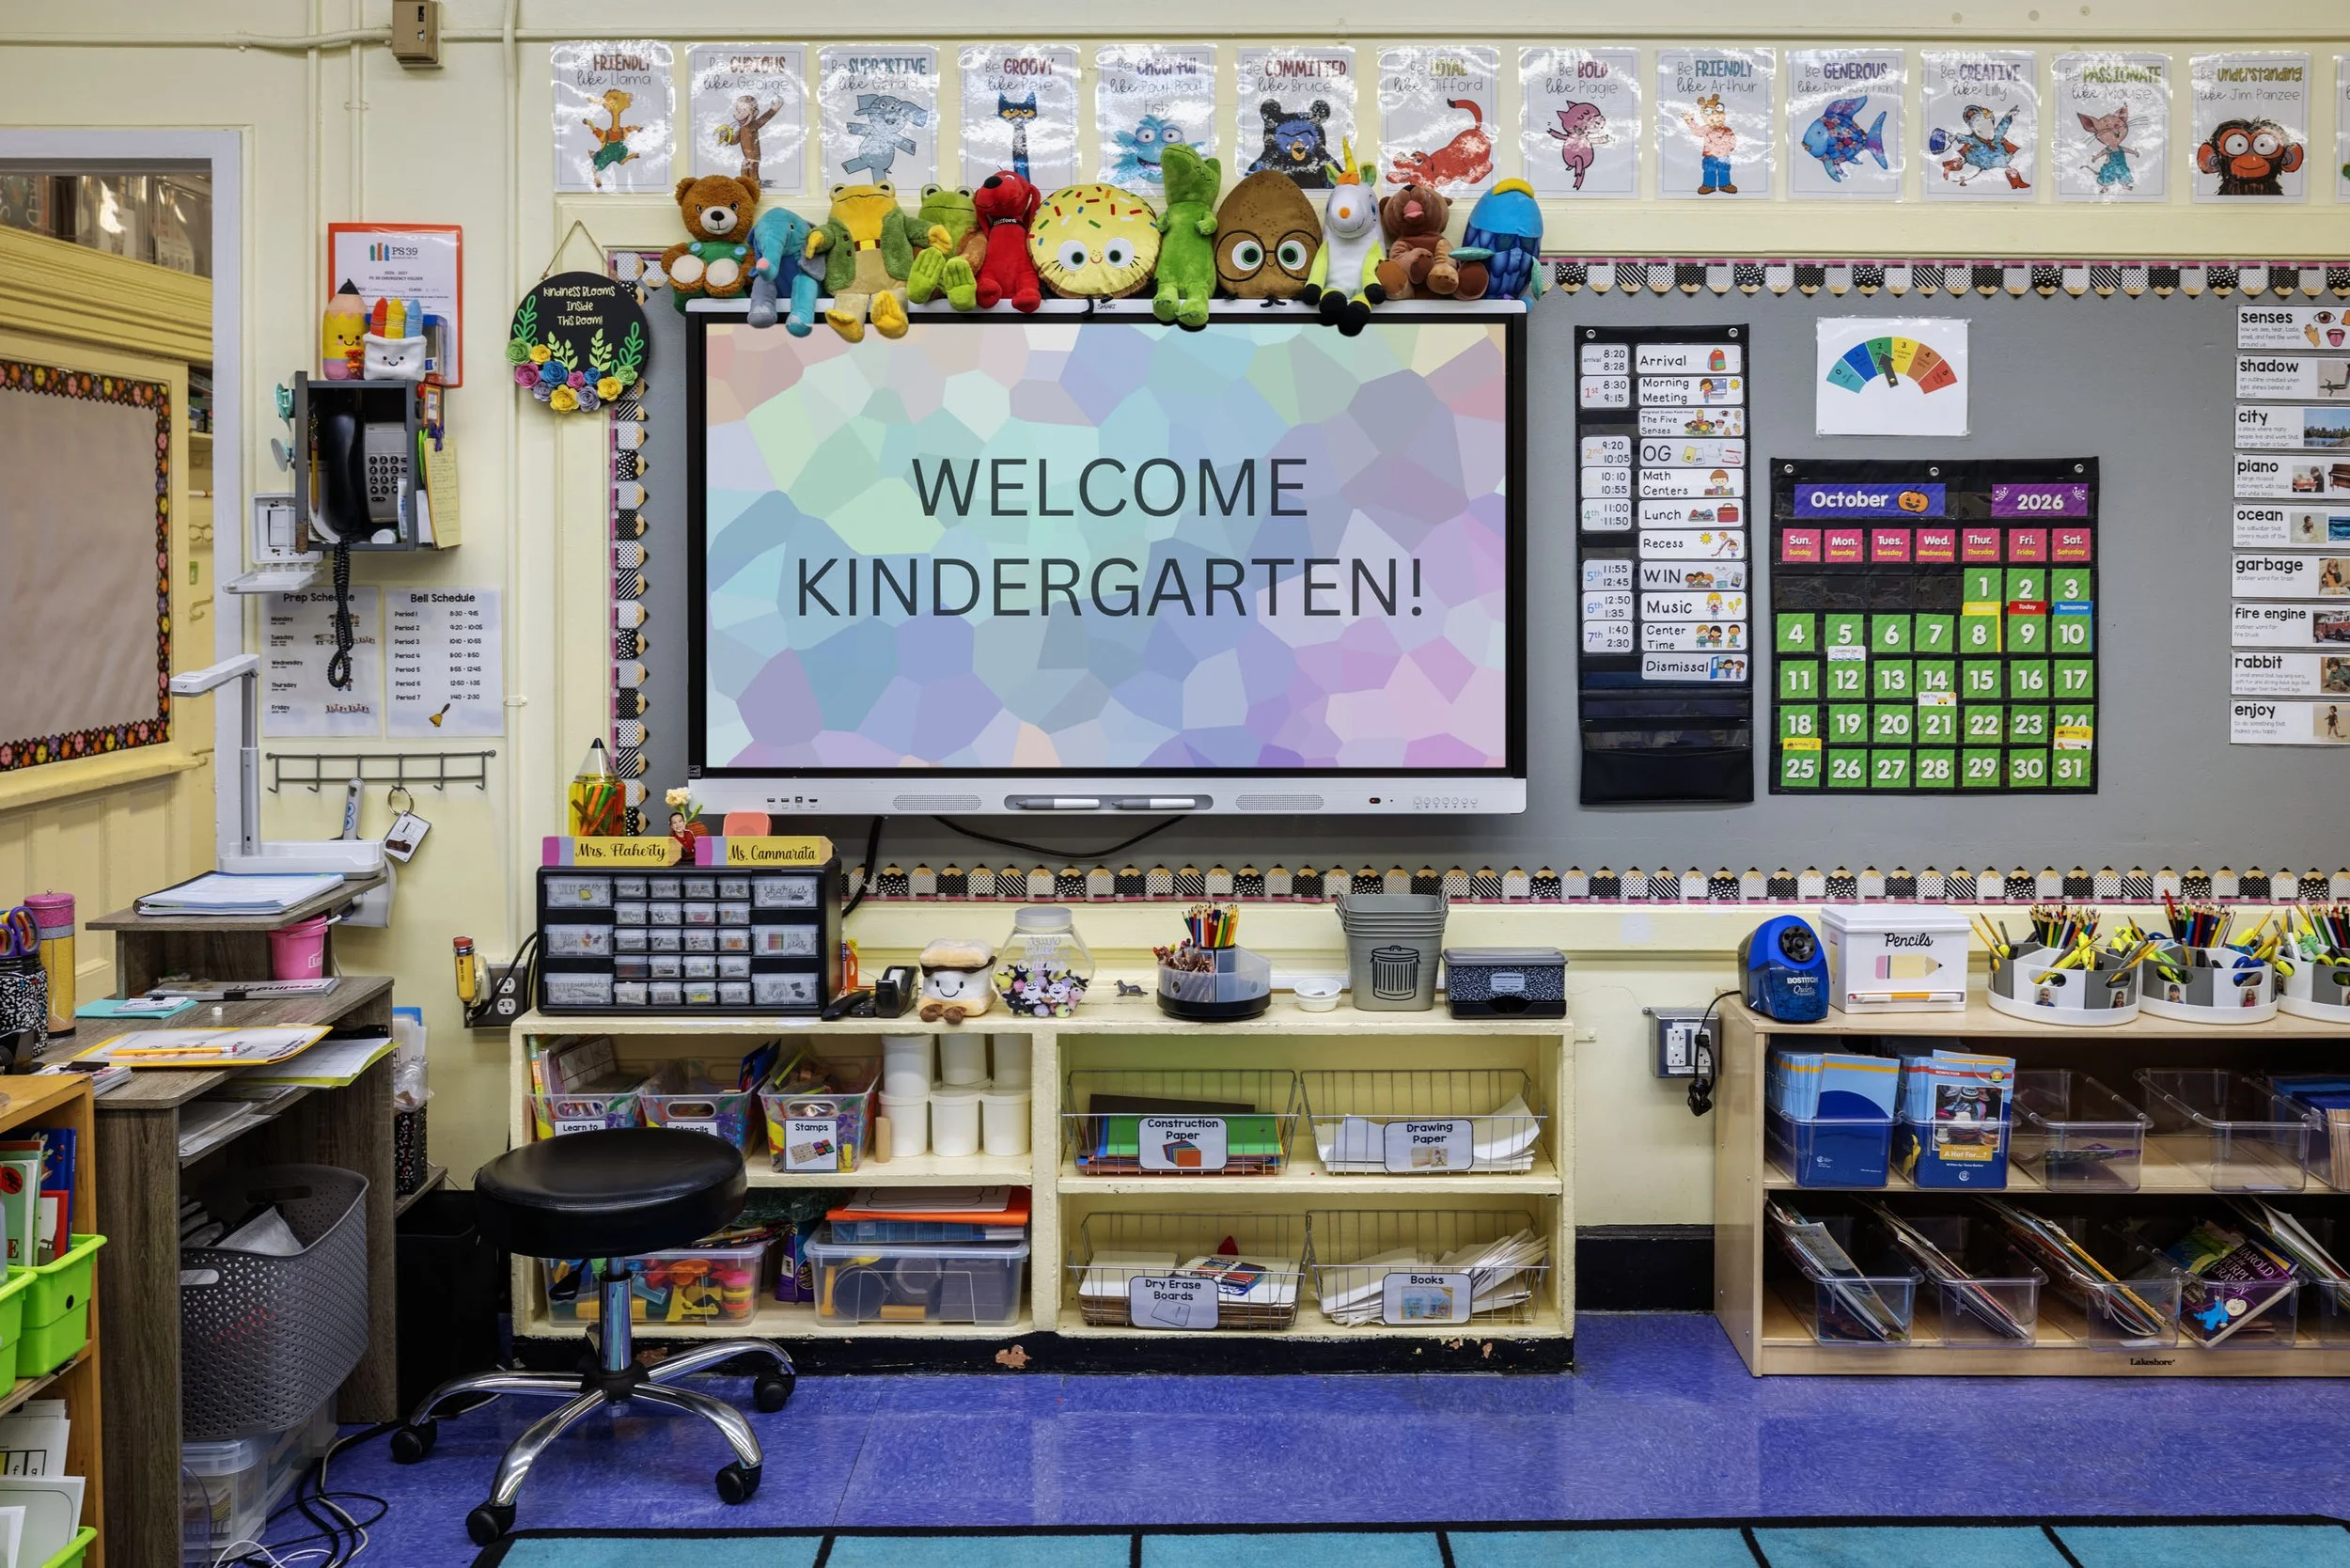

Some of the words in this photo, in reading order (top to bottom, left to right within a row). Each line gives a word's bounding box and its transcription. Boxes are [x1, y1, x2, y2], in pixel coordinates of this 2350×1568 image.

[985, 59, 1002, 74] Be
[1265, 60, 1346, 77] COMMITTED
[1430, 59, 1467, 76] LOYAL
[1559, 62, 1574, 77] Be
[1577, 61, 1607, 79] BOLD
[1678, 61, 1693, 75] Be
[1695, 60, 1752, 78] FRIENDLY
[1824, 63, 1887, 80] GENEROUS
[1940, 66, 1955, 79] Be
[1958, 64, 2020, 82] CREATIVE
[988, 75, 1019, 91] like
[1258, 78, 1288, 93] like
[1291, 79, 1331, 93] Bruce
[1393, 78, 1422, 93] like
[1429, 78, 1482, 93] Clifford
[1546, 77, 1575, 94] like
[1579, 80, 1619, 96] Piggie
[1676, 78, 1707, 94] like
[1711, 78, 1757, 93] Arthur
[1952, 82, 1982, 97] like
[1985, 83, 2008, 102] Lilly
[2200, 88, 2226, 102] like
[2230, 88, 2252, 101] Jim
[2257, 88, 2300, 101] Panzee
[392, 246, 404, 256] PS
[406, 246, 418, 256] 39
[2241, 312, 2293, 323] senses
[1603, 350, 1625, 359] 8:20
[1639, 355, 1686, 367] Arrival
[1604, 362, 1625, 371] 8:28
[2240, 358, 2299, 373] shadow
[1603, 381, 1626, 390] 8:30
[1642, 378, 1689, 390] Morning
[1605, 394, 1624, 402] 9:15
[1643, 393, 1687, 404] Meeting
[1641, 416, 1657, 424] The
[1661, 416, 1678, 424] Five
[2238, 410, 2267, 426] city
[1602, 441, 1623, 450] 9:20
[1604, 454, 1630, 463] 10:05
[1642, 446, 1671, 462] OG
[2237, 460, 2279, 475] piano
[1601, 472, 1626, 481] 10:10
[1643, 471, 1670, 480] Math
[912, 457, 1307, 518] WELCOME
[1601, 485, 1627, 494] 10:55
[1643, 485, 1689, 495] Centers
[1810, 491, 1889, 510] October
[2016, 494, 2064, 510] 2026
[1604, 503, 1628, 513] 11:00
[1604, 516, 1628, 525] 11:50
[1644, 510, 1681, 521] Lunch
[2237, 510, 2283, 521] ocean
[1644, 539, 1684, 548] Recess
[1789, 535, 1811, 545] Sun.
[1831, 536, 1857, 546] Mon.
[1877, 536, 1903, 546] Tues.
[1923, 535, 1950, 545] Wed.
[1967, 534, 1992, 545] Thur.
[2018, 535, 2036, 545] Fri.
[2062, 535, 2083, 545] Sat.
[1604, 565, 1627, 573] 11:55
[2235, 557, 2303, 574] garbage
[1644, 569, 1681, 584] WIN
[799, 557, 1422, 618] KINDERGARTEN!
[1979, 576, 1987, 597] 1
[2019, 579, 2033, 600] 2
[2064, 579, 2078, 600] 3
[283, 593, 308, 604] Prep
[410, 593, 428, 603] Bell
[431, 593, 476, 603] Schedule
[1605, 596, 1630, 604] 12:50
[1605, 609, 1624, 618] 1:35
[1646, 601, 1692, 614] Music
[2234, 607, 2260, 619] fire
[2264, 608, 2306, 621] engine
[1608, 625, 1628, 635] 1:40
[1646, 625, 1686, 635] Center
[1788, 623, 1805, 644] 4
[1838, 624, 1852, 644] 5
[1885, 624, 1899, 644] 6
[1929, 624, 1943, 644] 7
[1972, 624, 1986, 645] 8
[2021, 623, 2035, 644] 9
[2060, 623, 2084, 644] 10
[1606, 639, 1629, 648] 2:30
[1647, 639, 1674, 650] Time
[1646, 661, 1708, 672] Dismissal
[2234, 655, 2282, 668] rabbit
[1788, 670, 1810, 691] 11
[1834, 669, 1858, 690] 12
[1881, 669, 1905, 690] 13
[1923, 669, 1948, 690] 14
[1969, 670, 1994, 691] 15
[2018, 669, 2043, 691] 16
[2063, 669, 2088, 690] 17
[2234, 703, 2276, 719] enjoy
[1788, 715, 1811, 735] 18
[1836, 714, 1860, 734] 19
[1880, 714, 1909, 735] 20
[1926, 714, 1950, 735] 21
[1969, 714, 1998, 735] 22
[2014, 714, 2044, 735] 23
[2060, 714, 2087, 727] 24
[1786, 759, 1814, 779] 25
[1833, 759, 1861, 779] 26
[1876, 759, 1905, 779] 27
[1920, 759, 1950, 779] 28
[1968, 758, 1997, 778] 29
[2013, 759, 2043, 779] 30
[2058, 758, 2082, 778] 31
[575, 843, 606, 857] Mrs.
[611, 842, 666, 861] Flaherty
[728, 845, 747, 861] Ms.
[751, 845, 816, 861] Cammarata
[1885, 933, 1934, 947] Pencils
[564, 1123, 588, 1132] Learn
[590, 1123, 599, 1132] to
[795, 1122, 828, 1134] Stamps
[1147, 1119, 1218, 1129] Construction
[1406, 1122, 1453, 1135] Drawing
[1166, 1131, 1200, 1142] Paper
[1412, 1134, 1448, 1145] Paper
[2236, 1247, 2274, 1278] HAROLD
[2221, 1258, 2256, 1282] PURPLE
[1145, 1279, 1166, 1292] Dry
[1168, 1280, 1201, 1291] Erase
[1410, 1275, 1445, 1285] Books
[2212, 1265, 2249, 1295] CRAYON
[1153, 1292, 1194, 1303] Boards
